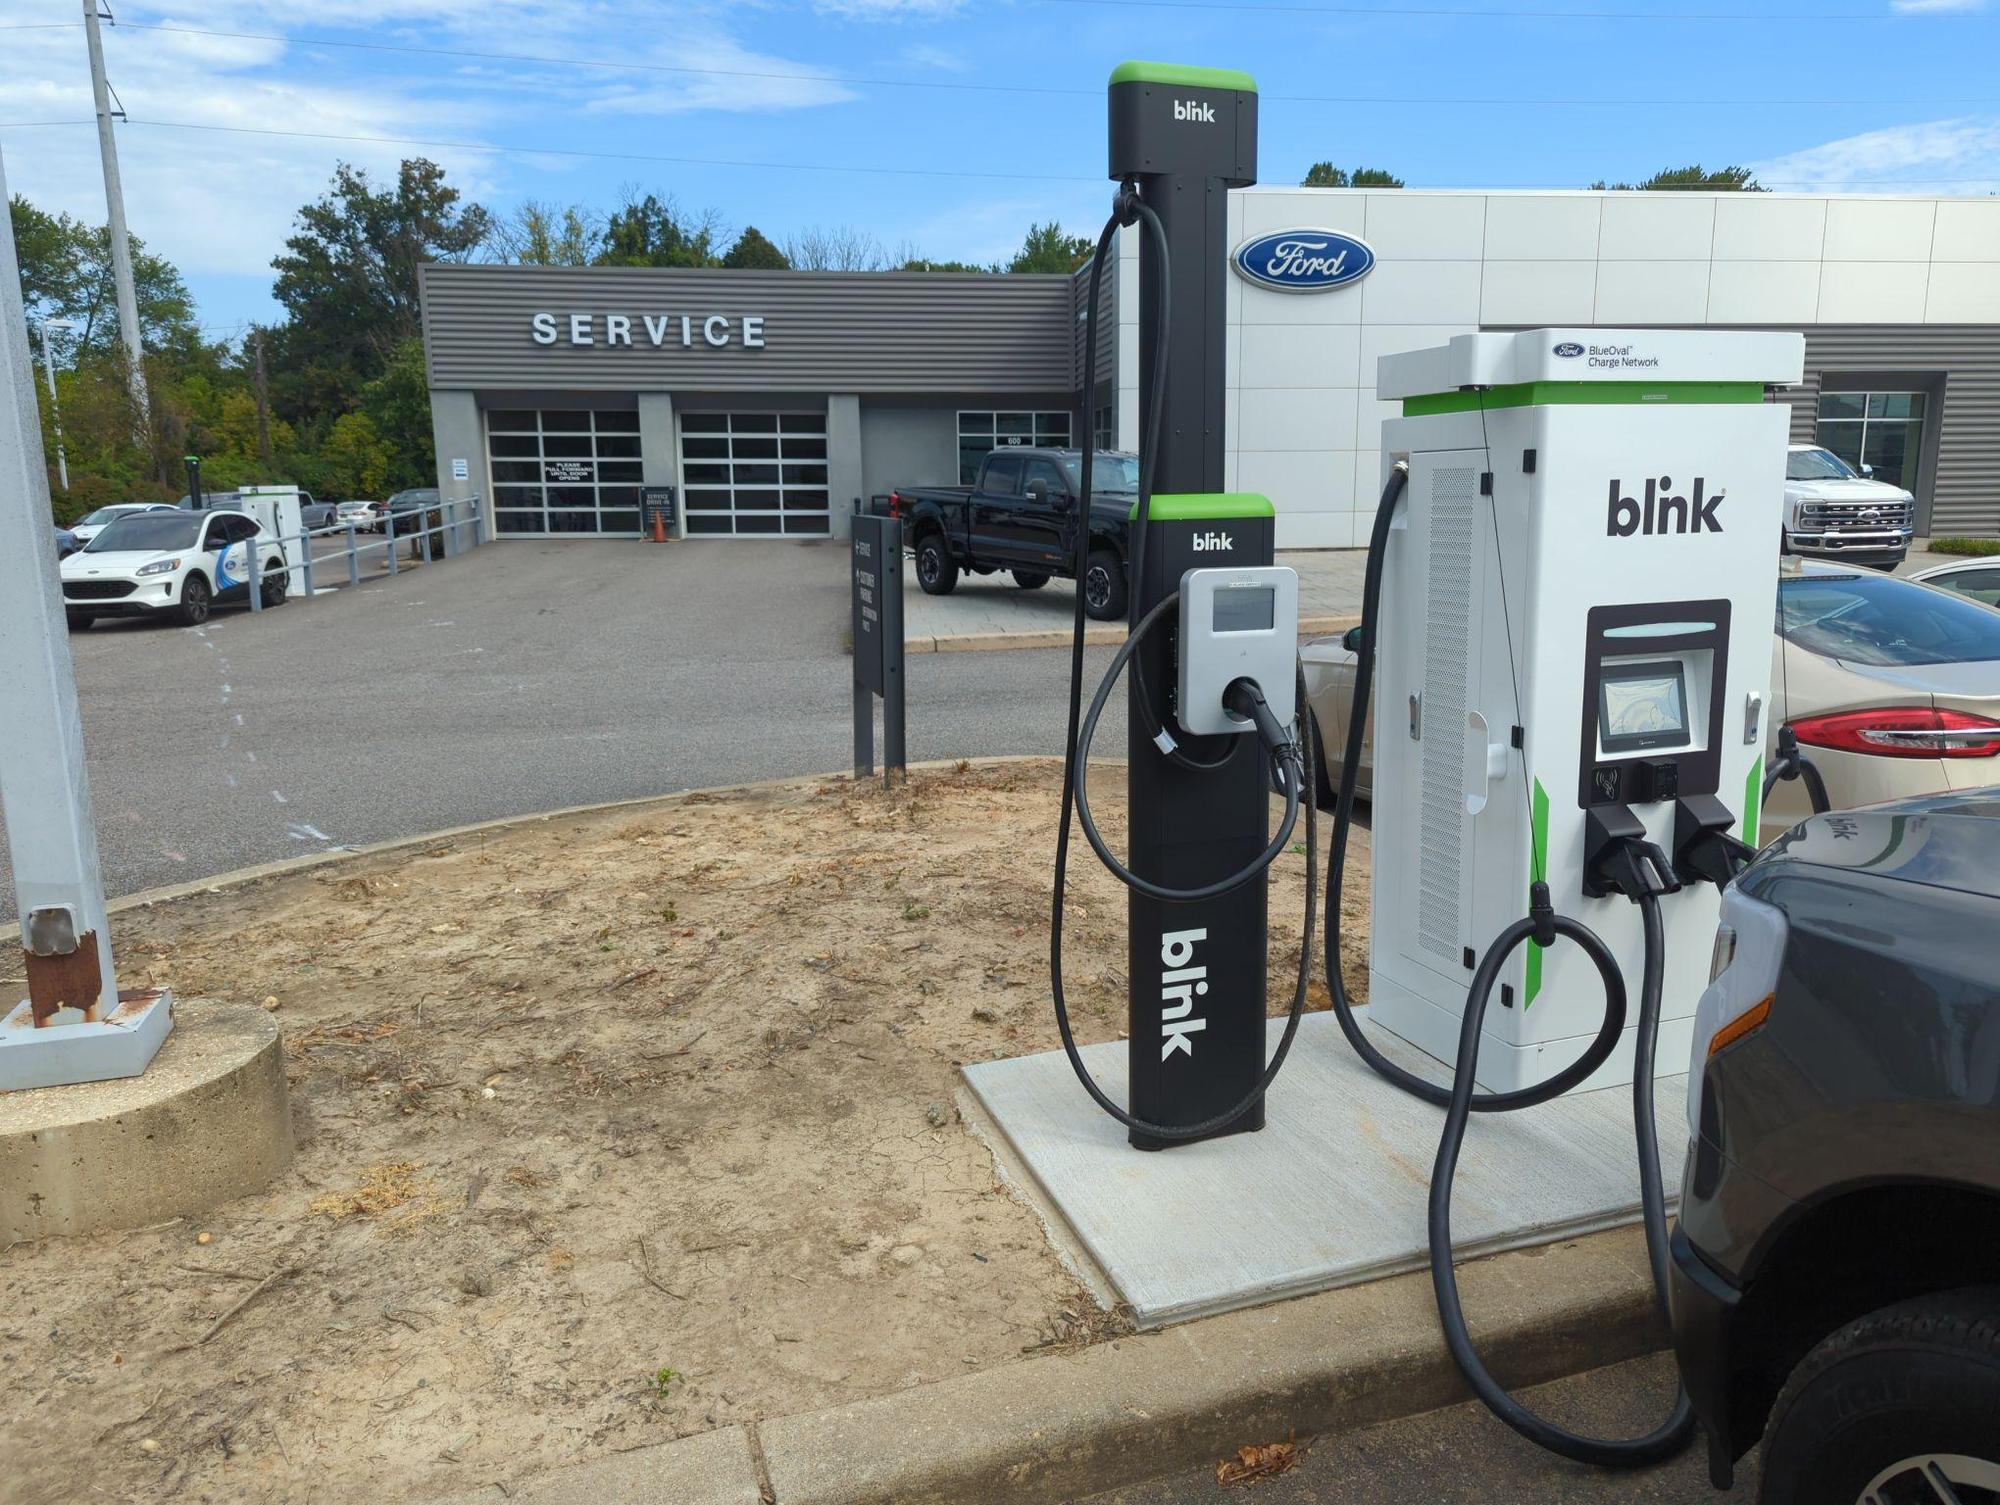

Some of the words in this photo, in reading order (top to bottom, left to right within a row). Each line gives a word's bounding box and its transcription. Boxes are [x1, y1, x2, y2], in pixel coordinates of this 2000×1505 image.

[1174, 100, 1215, 123] blink
[1266, 240, 1347, 277] Ford
[532, 313, 765, 347] SERVICE
[1558, 344, 1579, 356] Ford
[1588, 357, 1620, 369] Charge
[1621, 357, 1659, 367] Network
[1607, 475, 1726, 537] blink
[1193, 532, 1234, 551] blink
[1161, 928, 1209, 1063] blink
